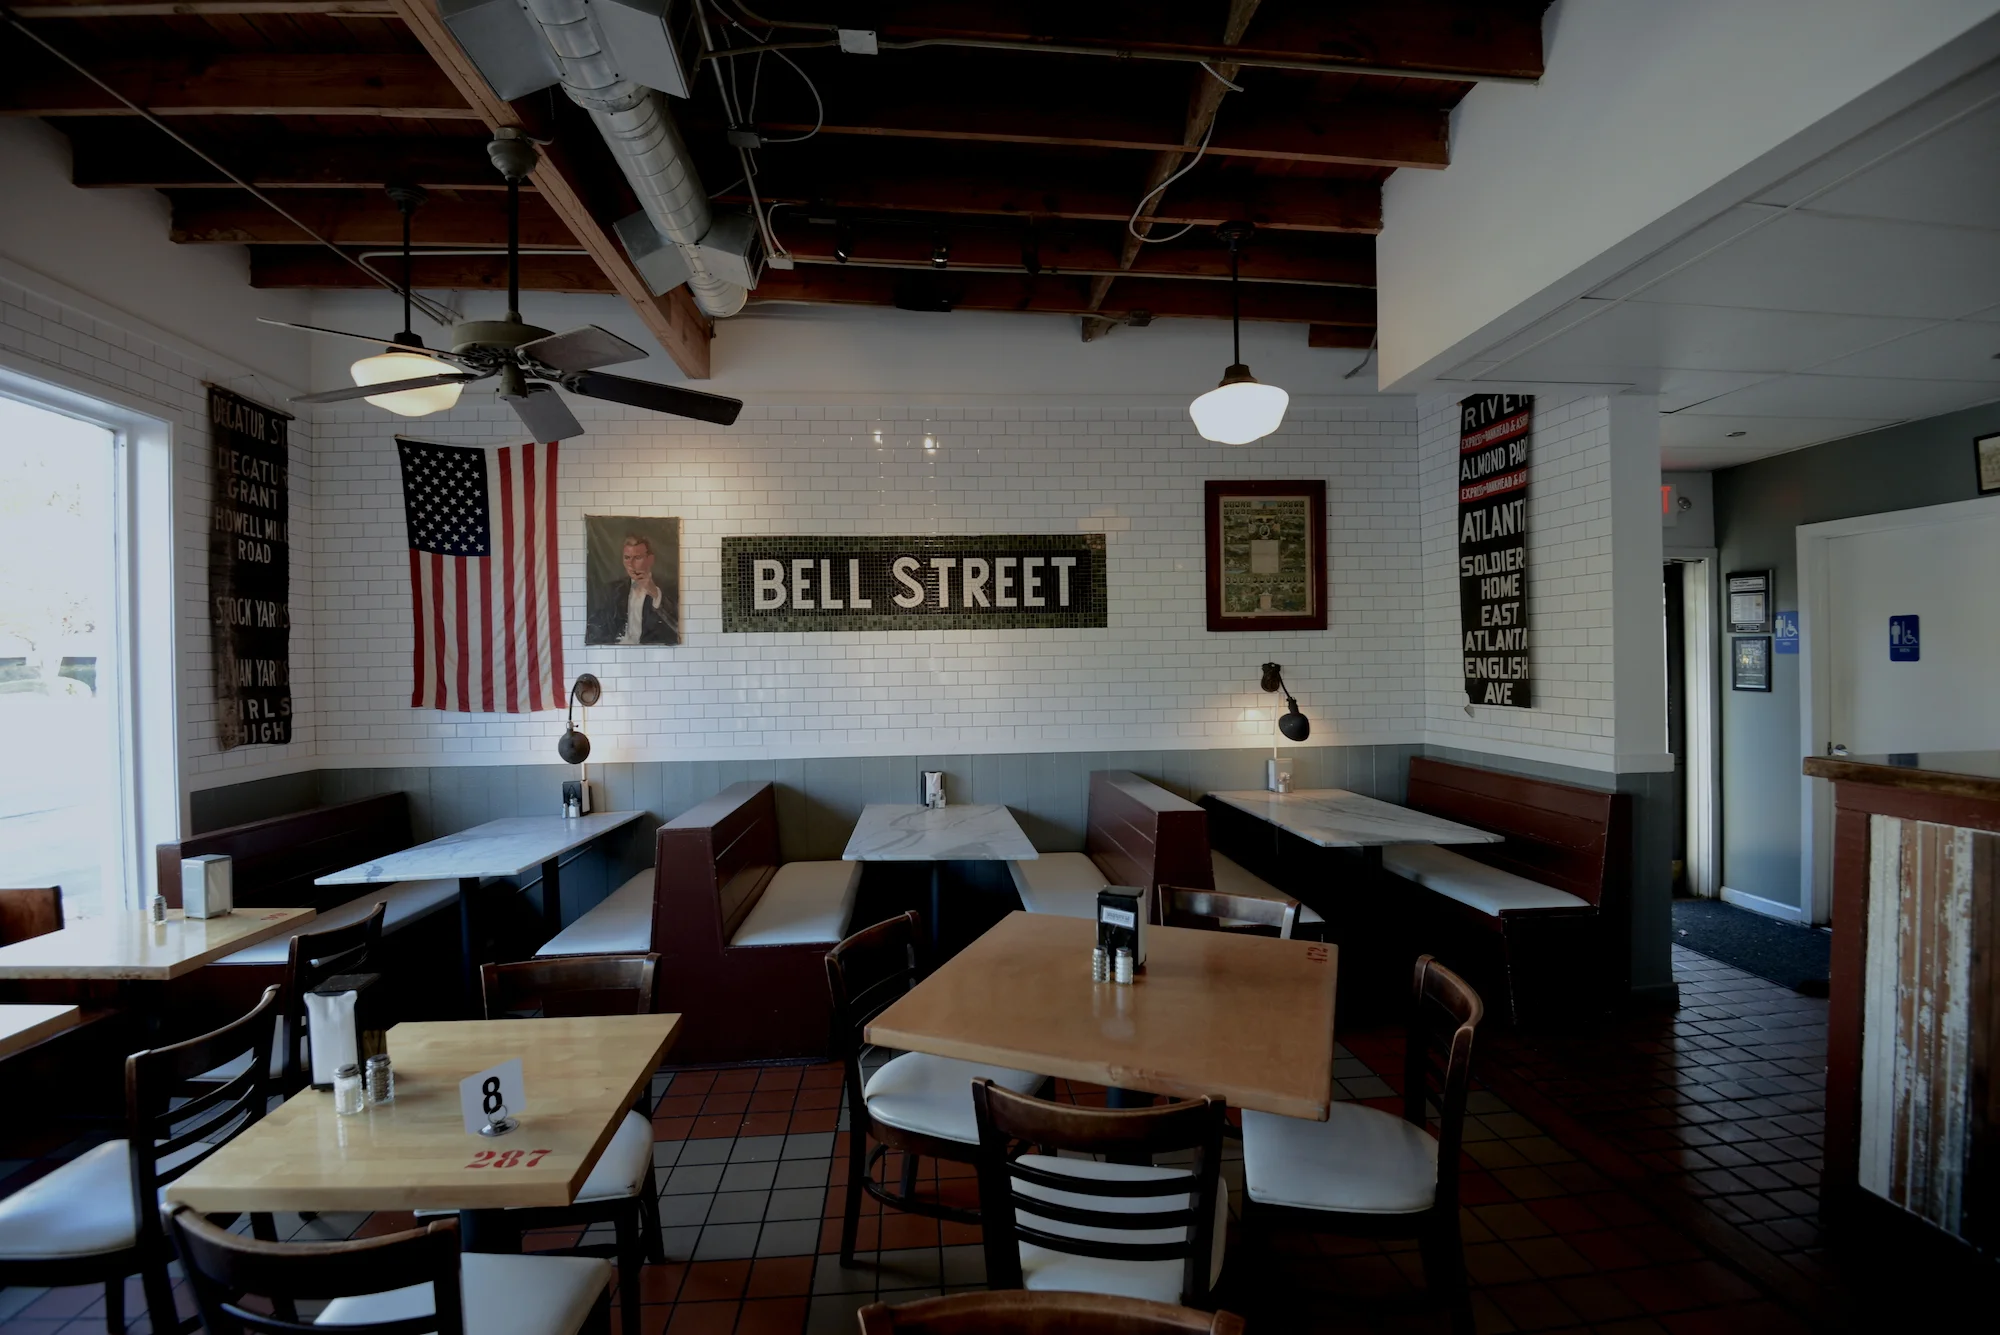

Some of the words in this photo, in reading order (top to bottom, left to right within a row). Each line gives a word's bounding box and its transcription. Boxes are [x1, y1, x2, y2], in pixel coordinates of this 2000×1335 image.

[213, 394, 265, 440] DECATUR
[1461, 447, 1506, 481] ALMOND
[227, 478, 278, 510] GRANT
[215, 506, 263, 538] HOWELL
[238, 538, 272, 563] ROAD
[1461, 547, 1525, 577] SOLDIER
[753, 558, 872, 610] BELL
[892, 556, 1076, 608] STREET
[1480, 573, 1520, 600] HOME
[1481, 602, 1520, 627] EAST
[1464, 627, 1528, 651] ATLANTA
[1465, 657, 1529, 679] ENGLISH
[1484, 682, 1513, 705] AVE
[482, 1076, 503, 1115] 8
[464, 1149, 553, 1169] 287
